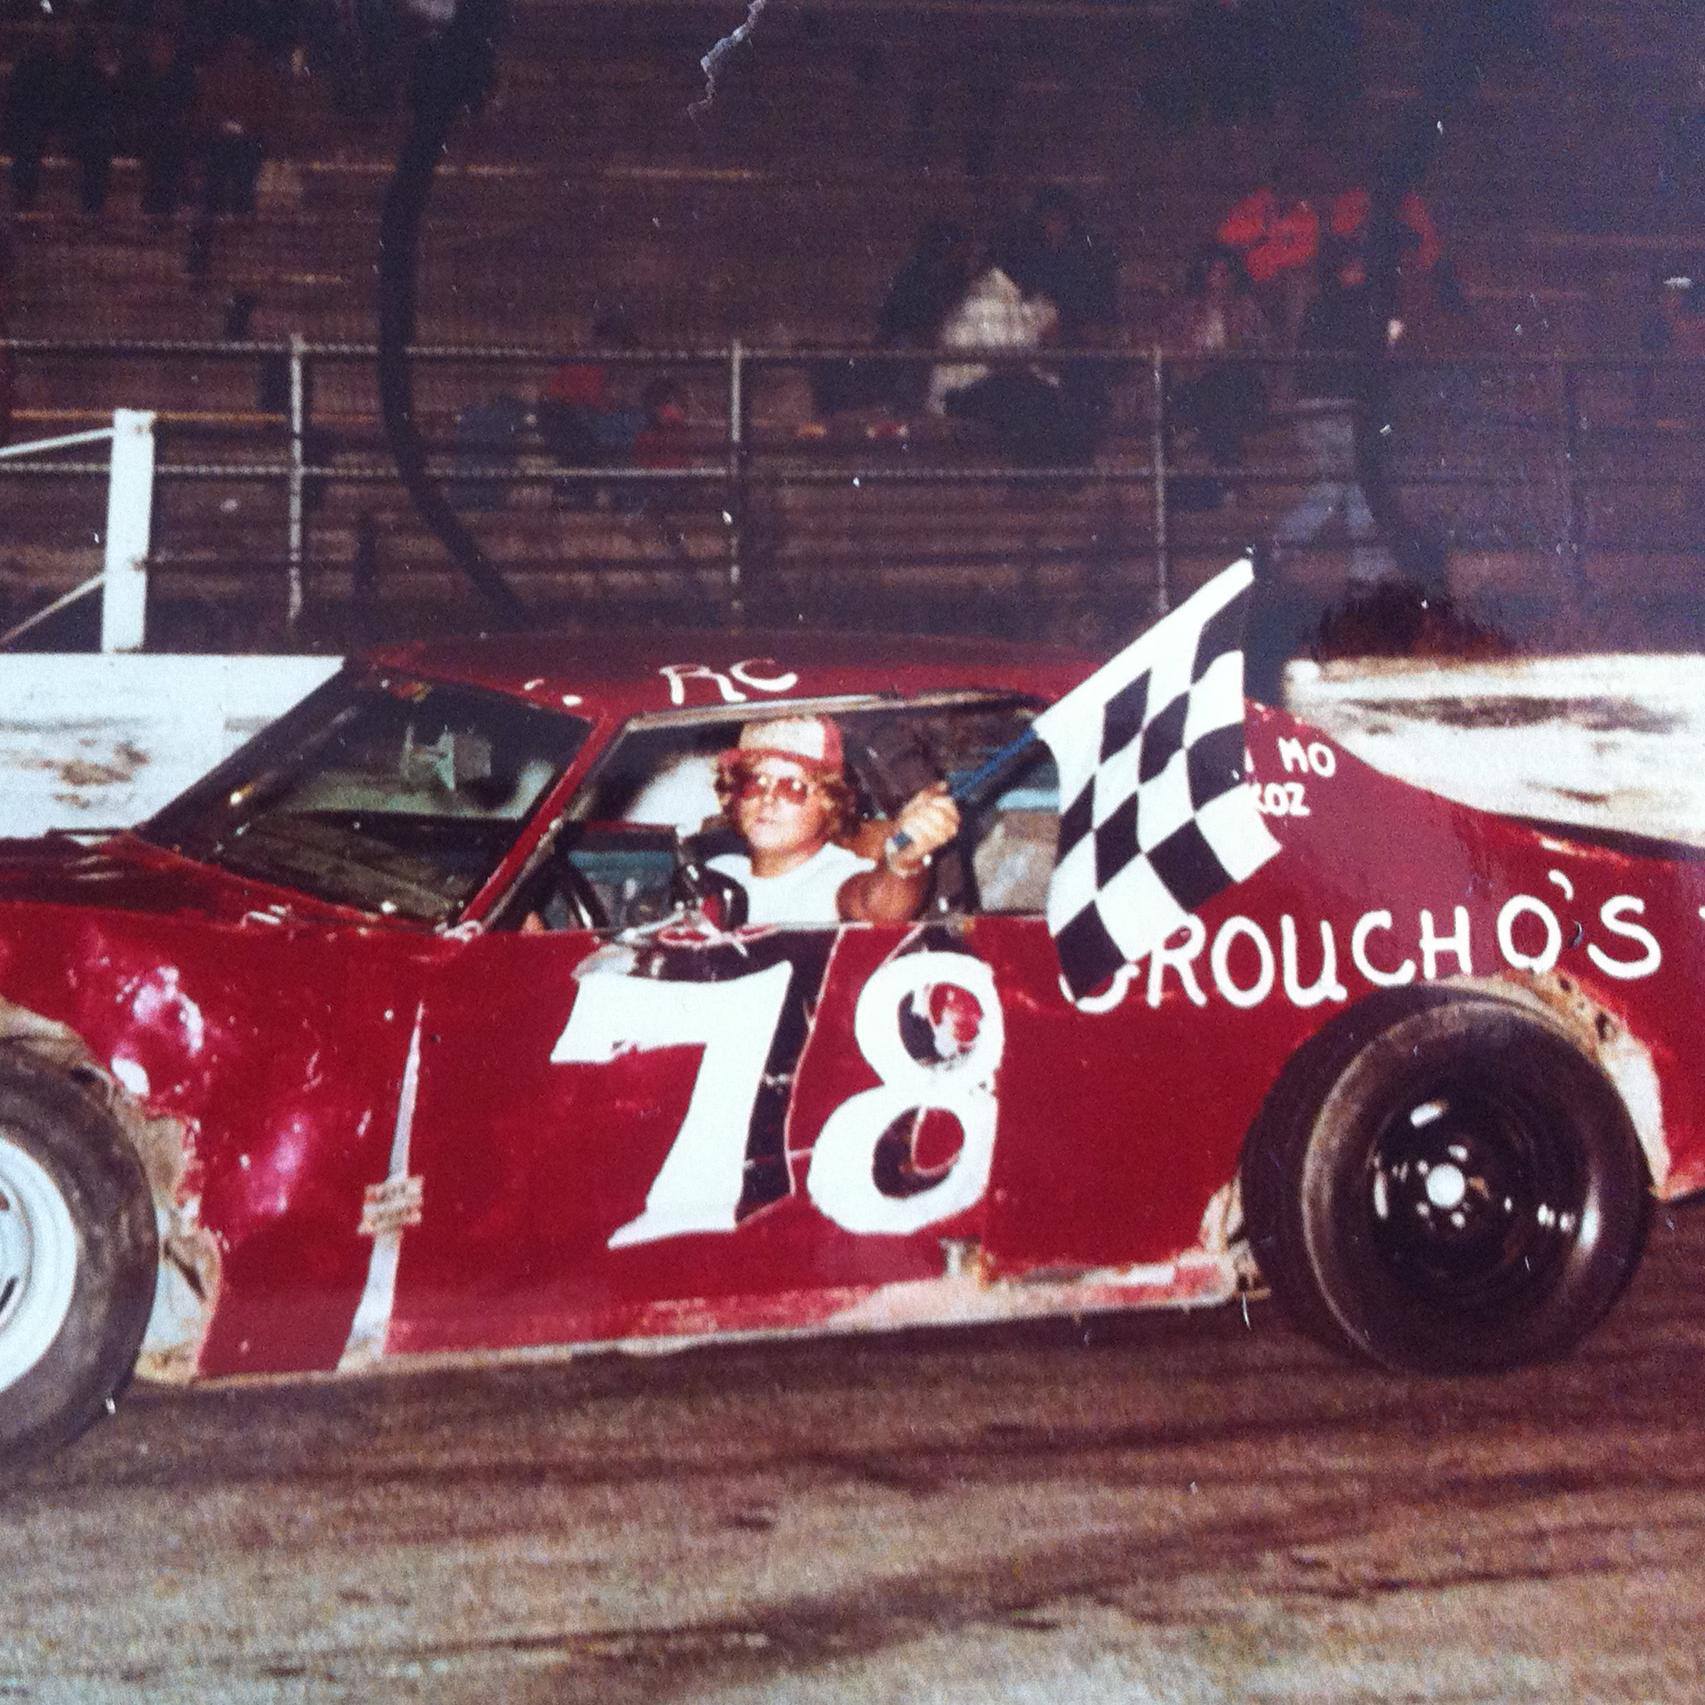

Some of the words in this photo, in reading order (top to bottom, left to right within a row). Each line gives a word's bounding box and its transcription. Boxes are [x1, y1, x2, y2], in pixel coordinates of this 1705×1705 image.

[658, 658, 798, 704] RC
[1277, 736, 1337, 778] MO
[549, 950, 1005, 1250] 78
